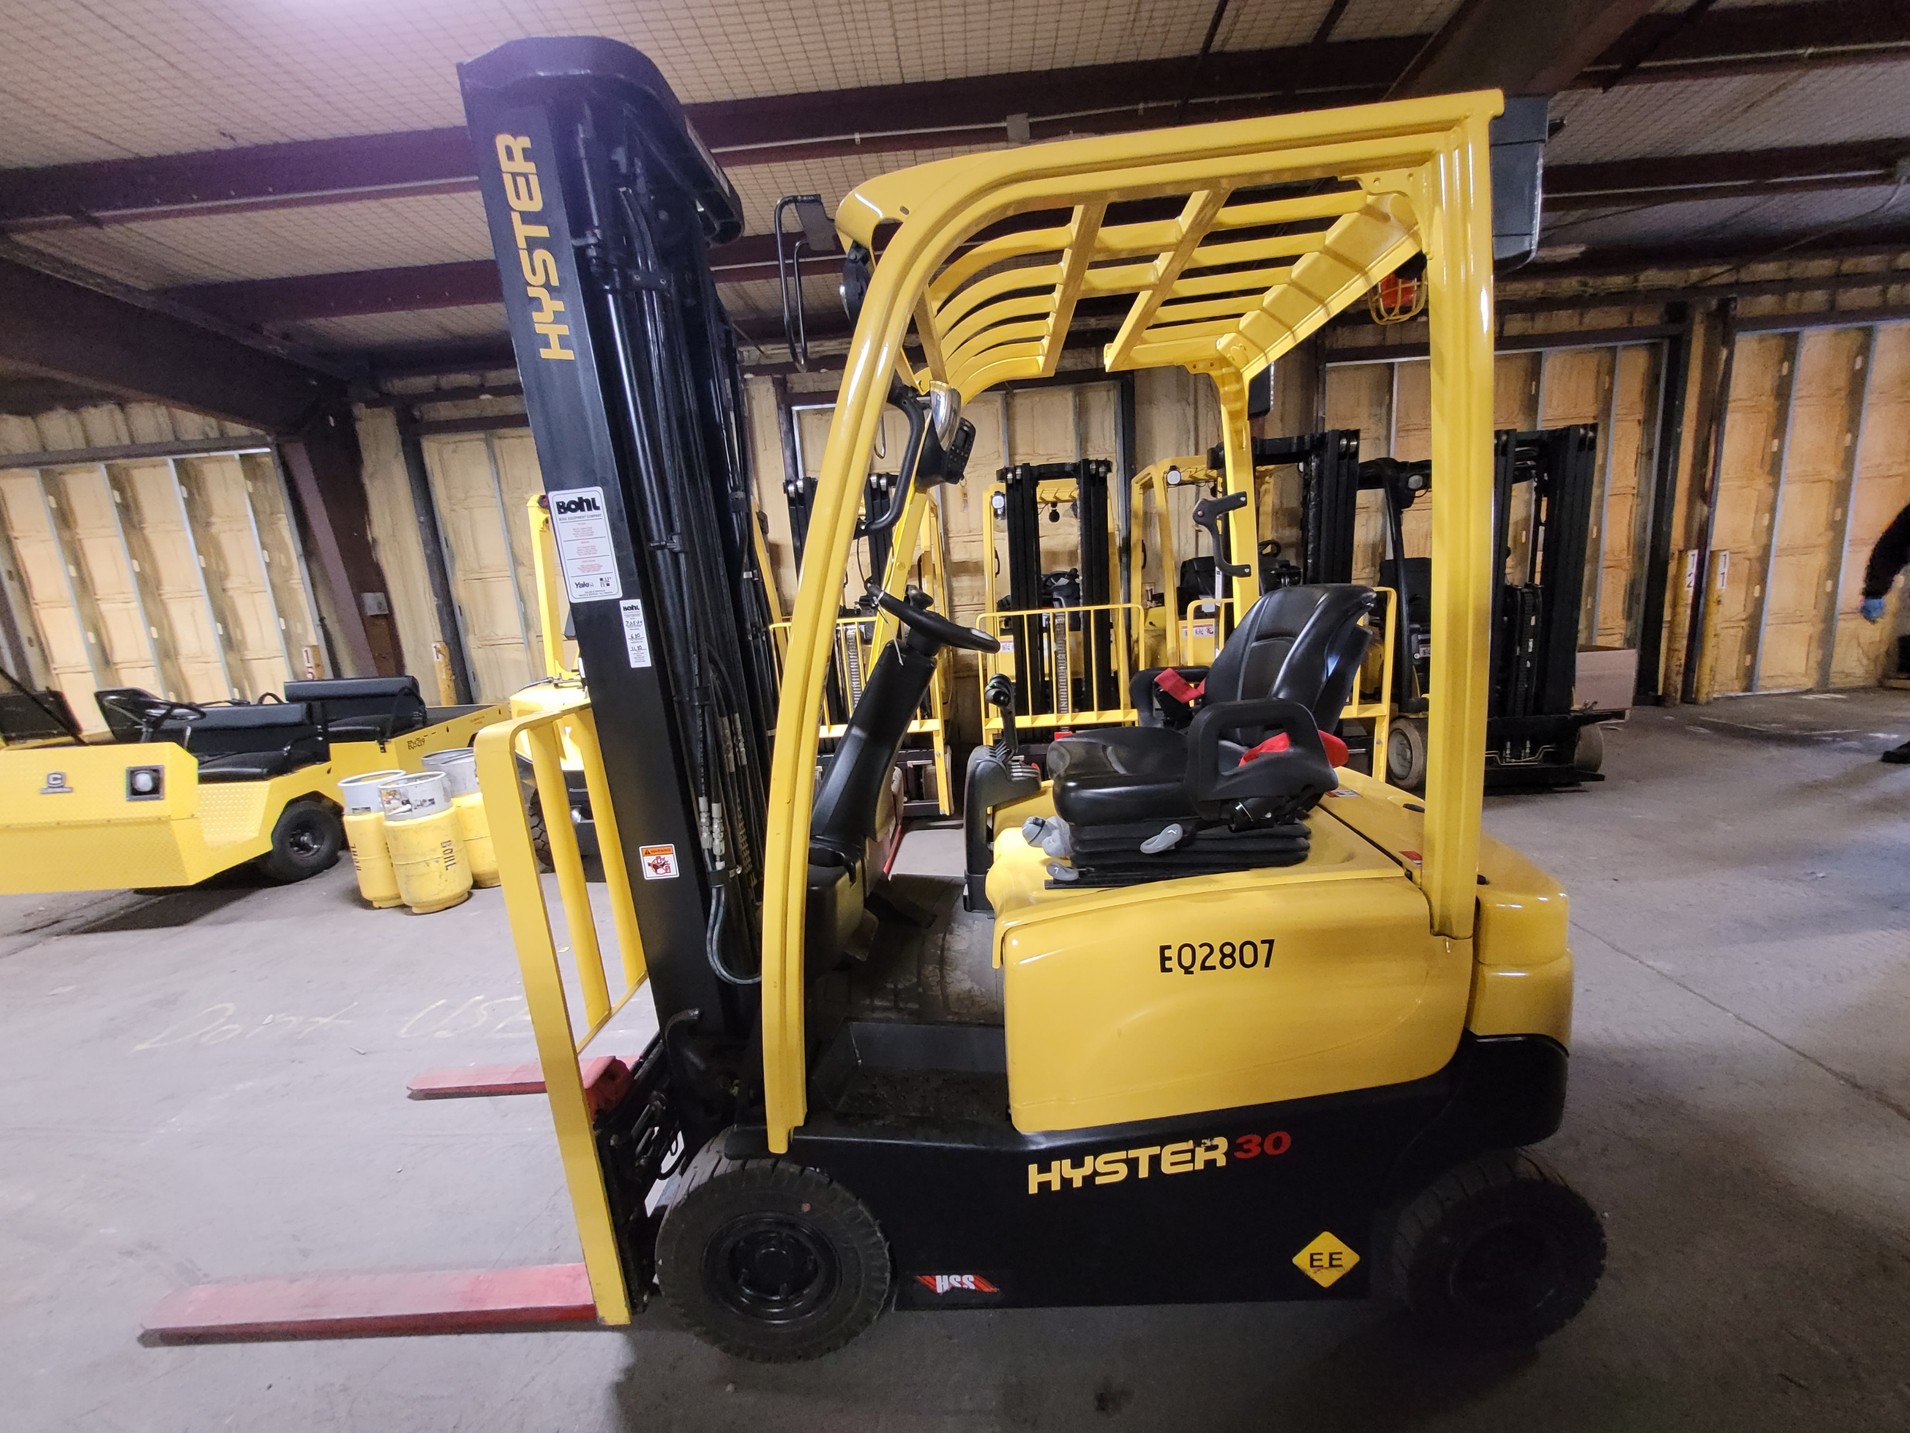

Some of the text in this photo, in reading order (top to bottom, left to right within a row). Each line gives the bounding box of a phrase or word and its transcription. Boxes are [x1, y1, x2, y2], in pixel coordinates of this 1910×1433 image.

[496, 134, 575, 361] HYSTER
[1159, 939, 1275, 975] EQ2807
[1028, 1130, 1292, 1195] HYSTER 30
